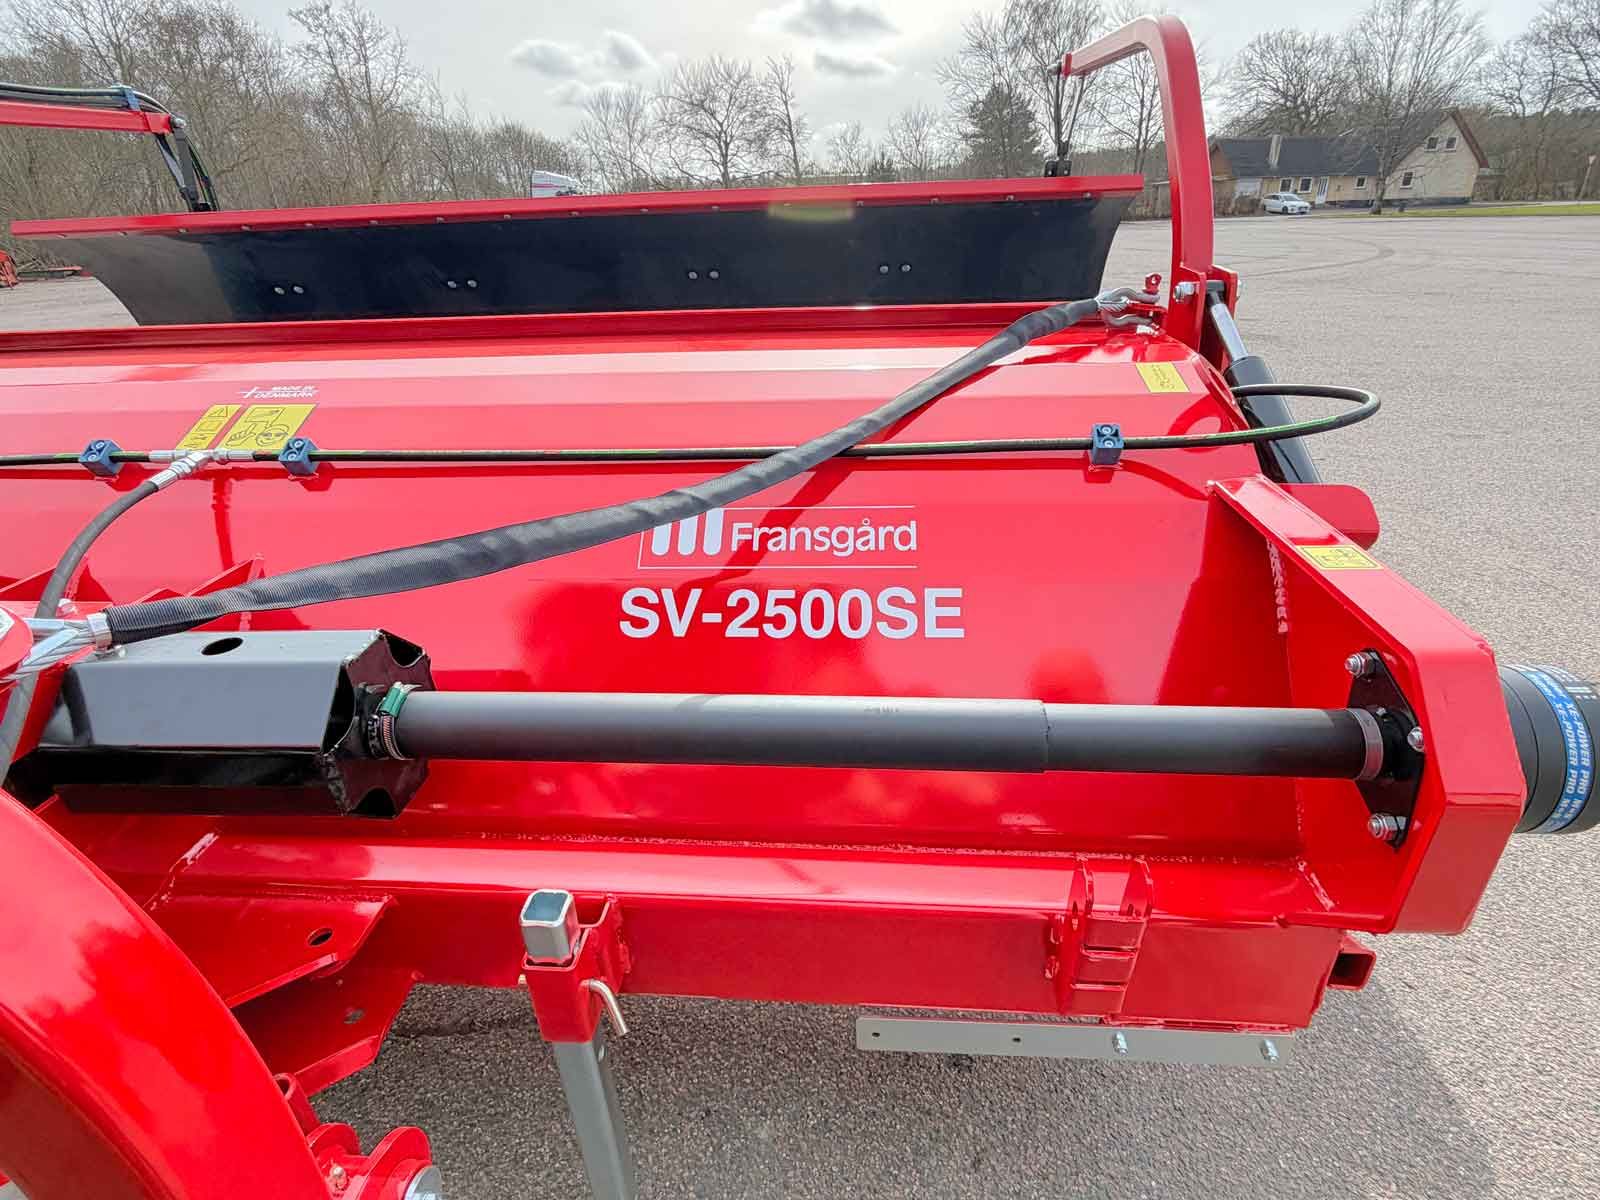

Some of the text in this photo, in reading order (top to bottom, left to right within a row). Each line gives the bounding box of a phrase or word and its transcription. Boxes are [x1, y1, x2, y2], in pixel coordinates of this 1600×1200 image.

[730, 518, 918, 557] Fransgård
[619, 586, 966, 640] SV-2500SE
[1565, 769, 1578, 795] PRO
[1577, 770, 1591, 795] PRO
